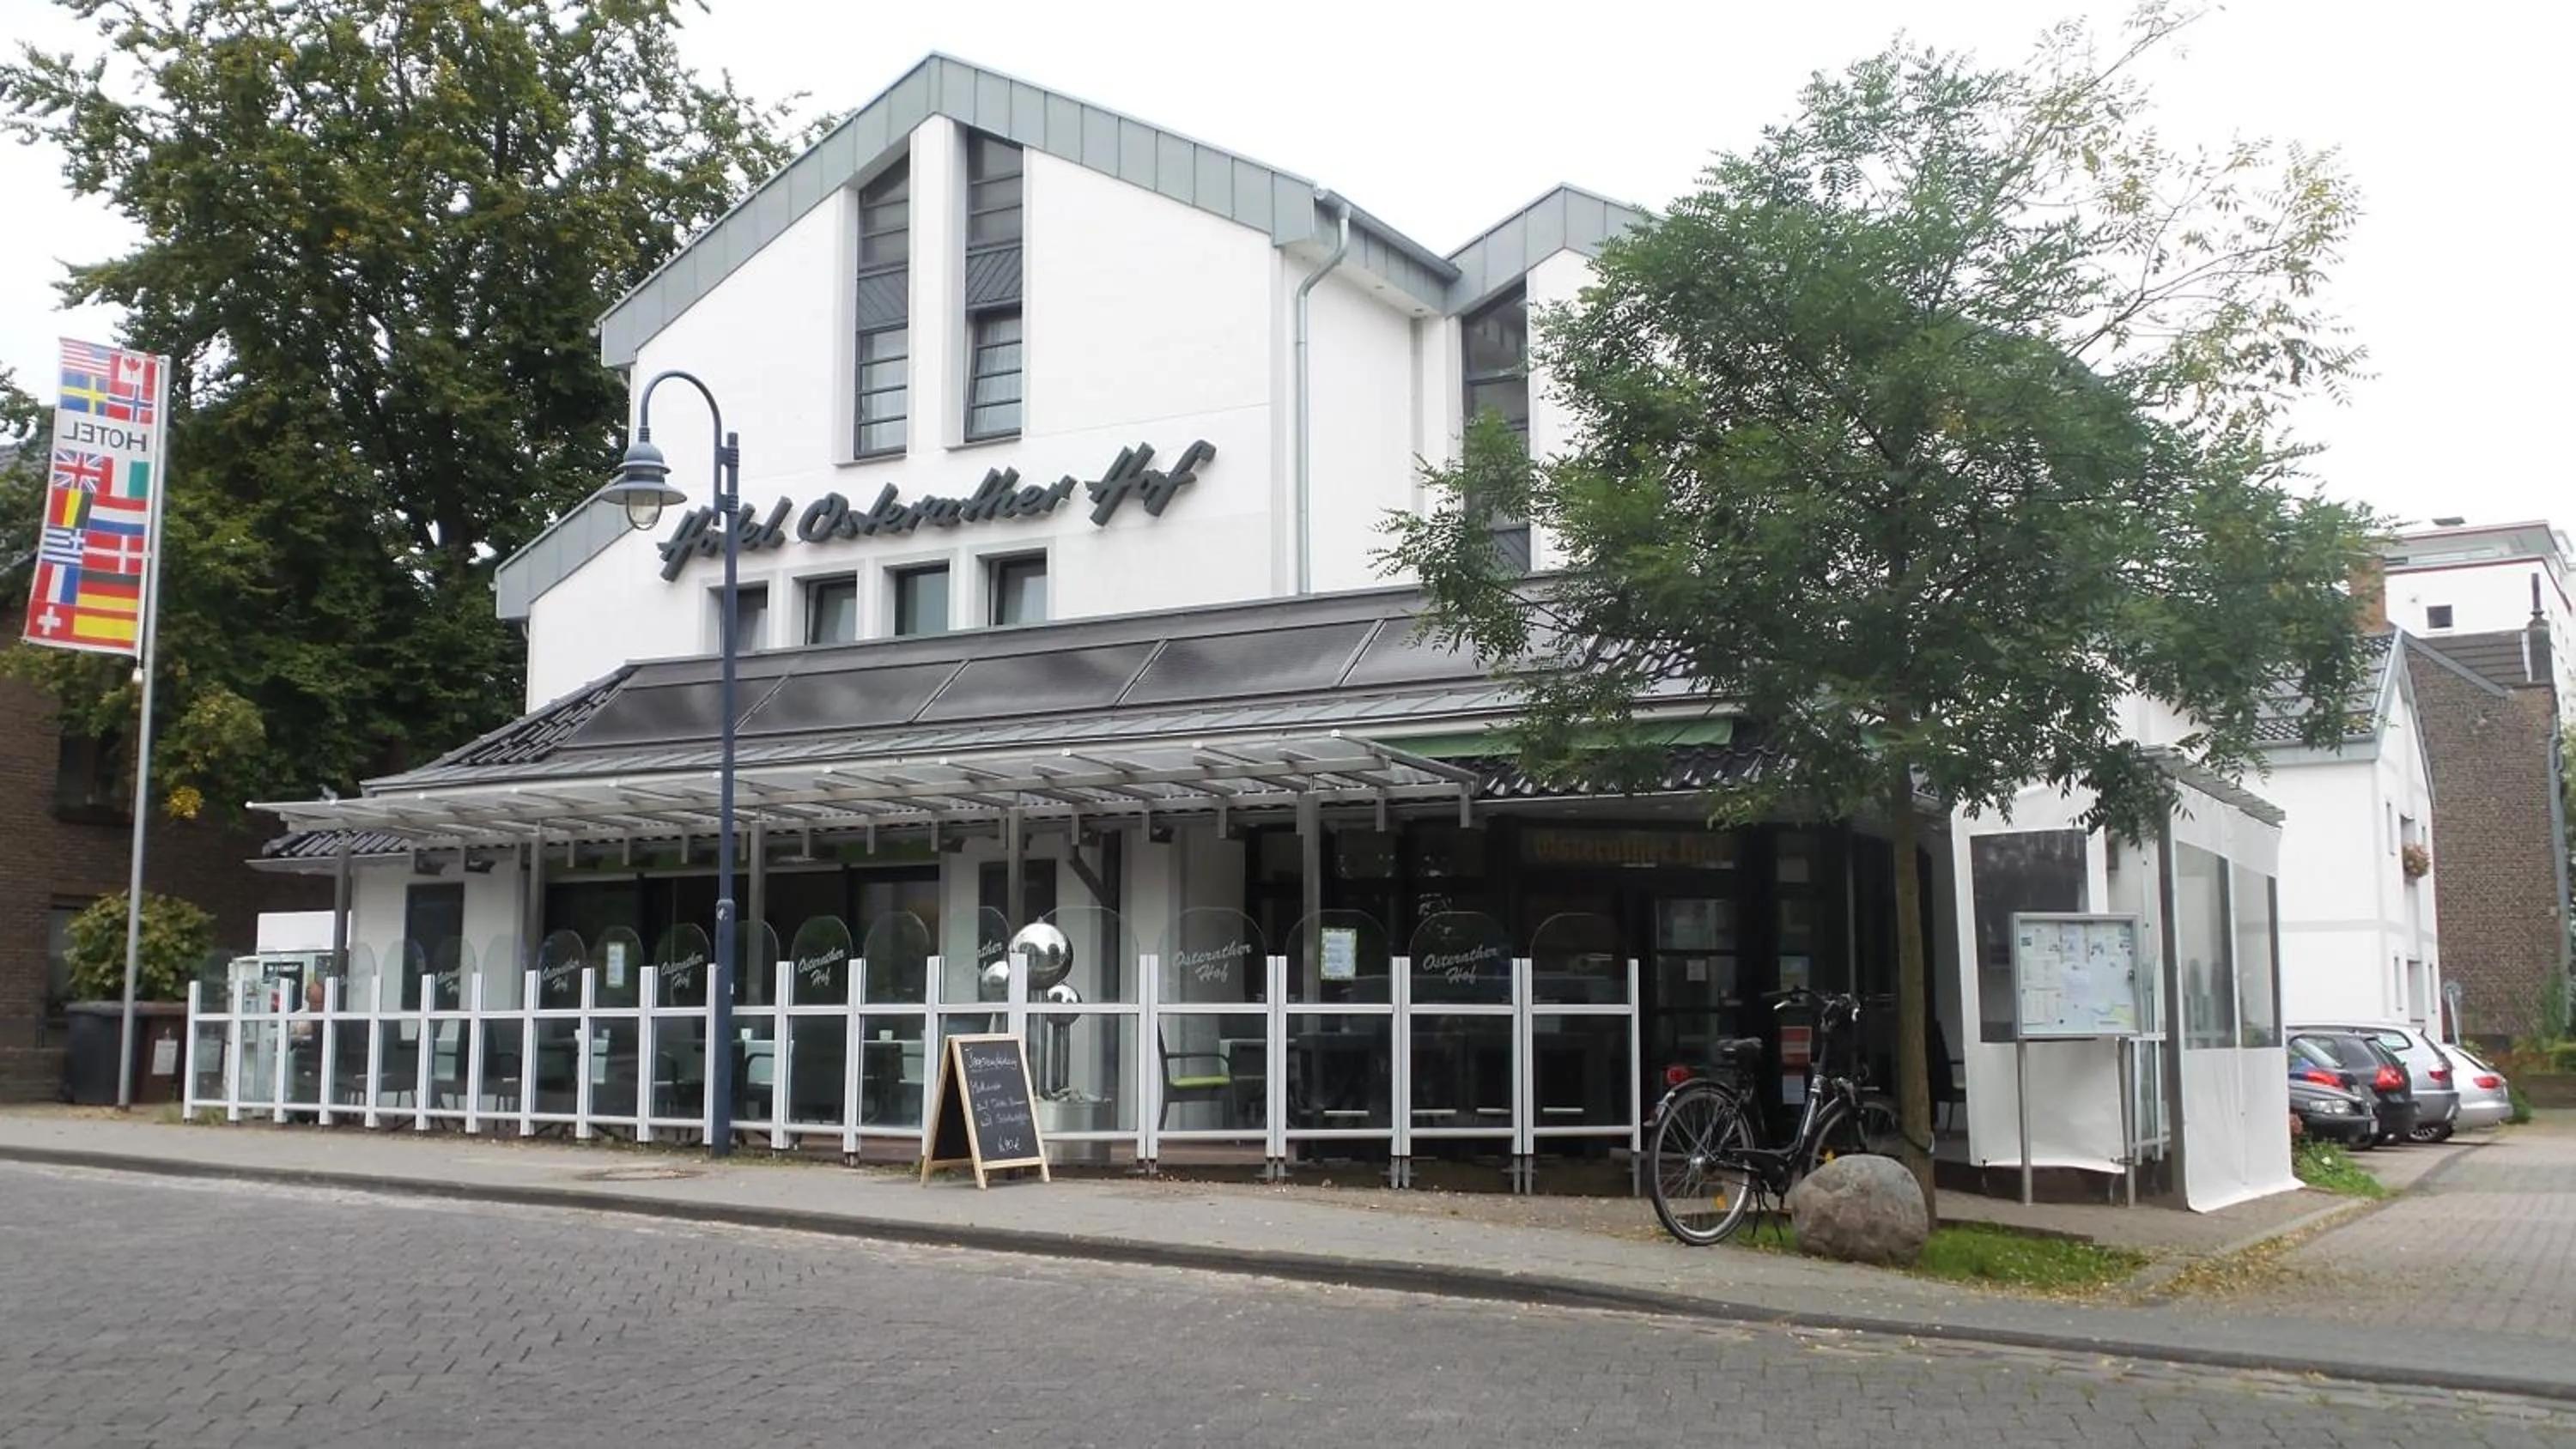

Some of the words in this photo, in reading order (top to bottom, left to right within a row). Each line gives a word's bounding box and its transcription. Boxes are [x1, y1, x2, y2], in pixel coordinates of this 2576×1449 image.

[797, 467, 1078, 543] Osterather
[1084, 440, 1217, 526] Hof
[798, 947, 845, 973] Osterather
[1173, 940, 1253, 967] Osterather
[1423, 944, 1499, 972] Osterather
[810, 967, 831, 987] Hof
[1194, 962, 1229, 983] Hof
[1446, 966, 1477, 985] Hof
